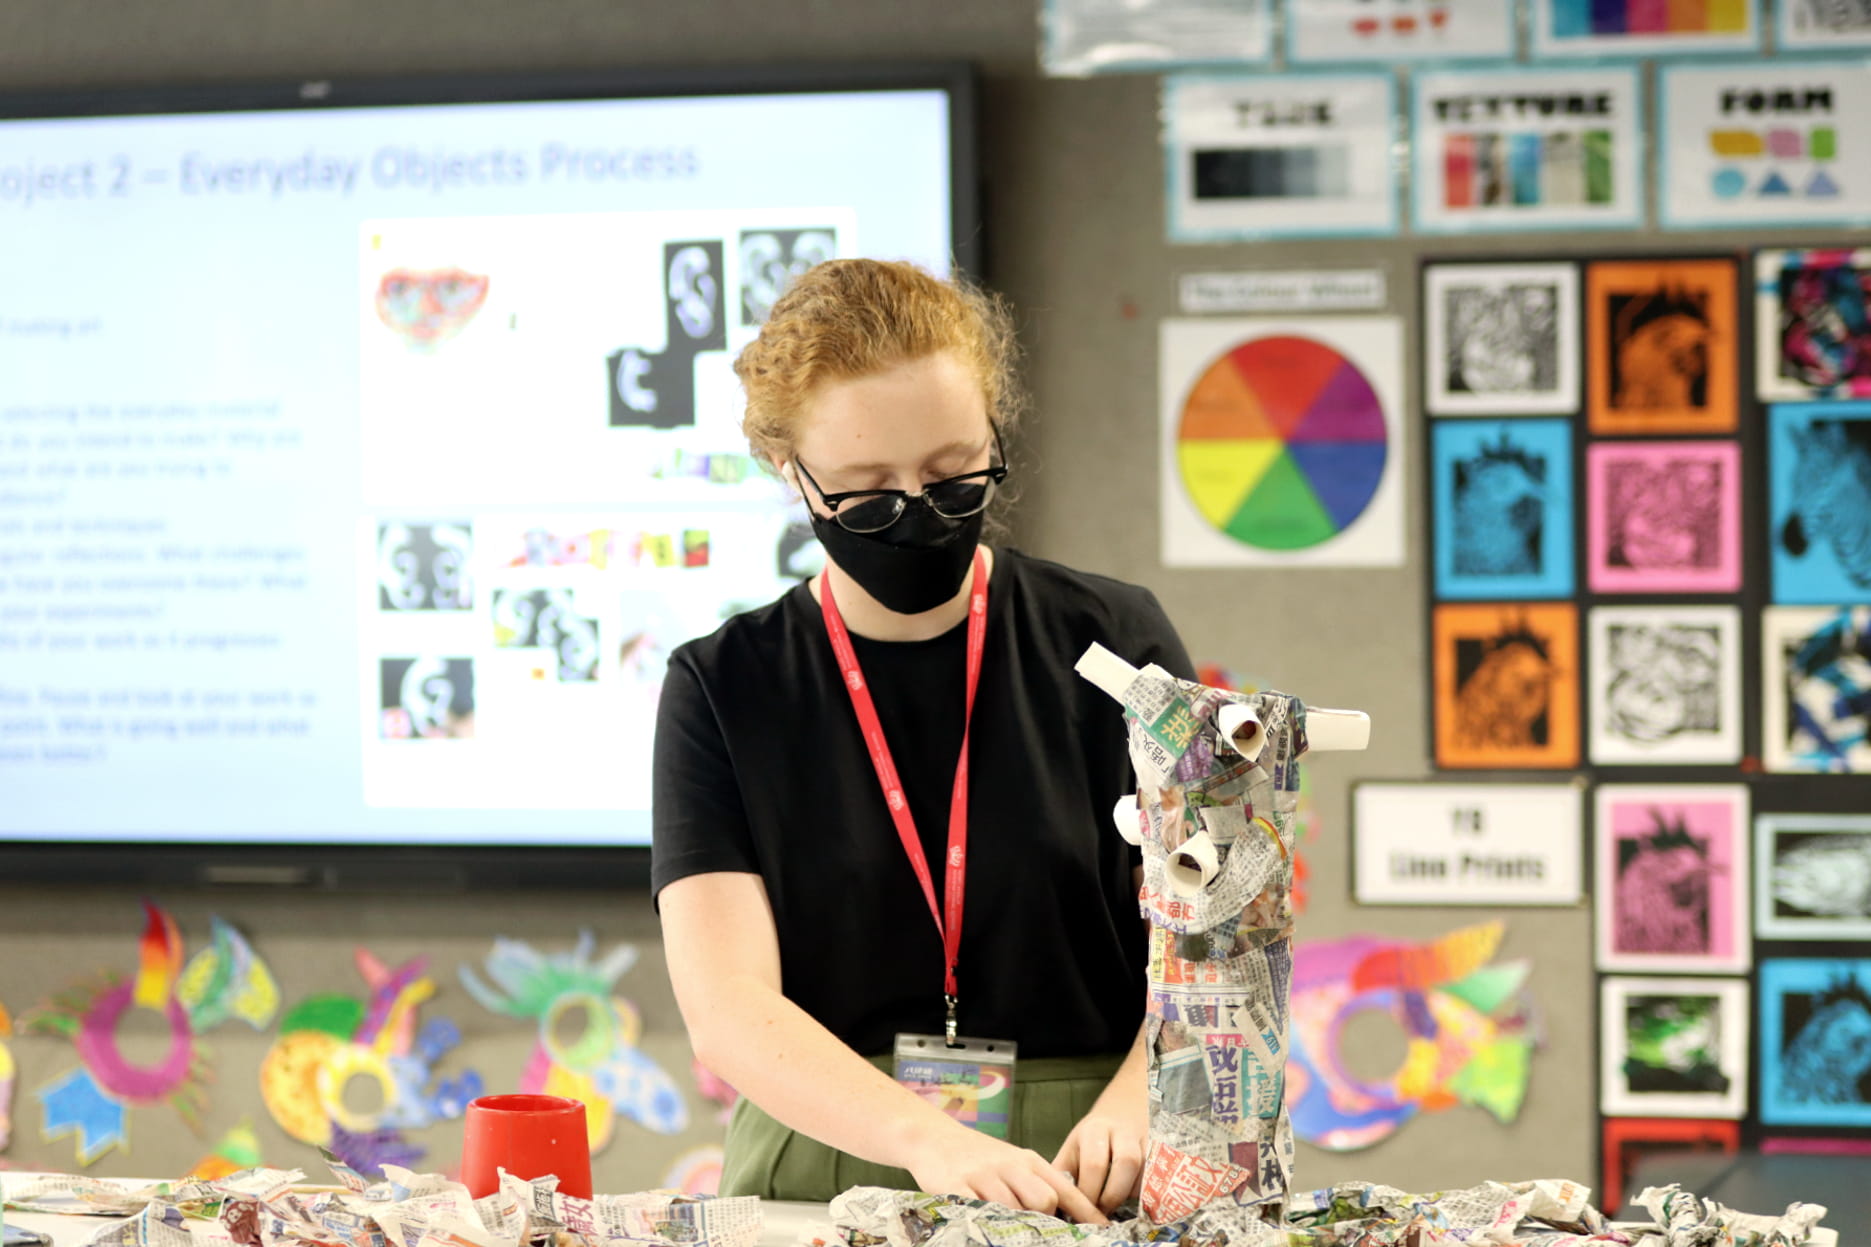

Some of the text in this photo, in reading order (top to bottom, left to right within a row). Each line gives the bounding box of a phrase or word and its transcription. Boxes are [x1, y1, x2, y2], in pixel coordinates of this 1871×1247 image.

[1719, 87, 1835, 114] FORM
[107, 152, 132, 196] 2
[179, 149, 361, 200] Everyday
[370, 145, 529, 193] Objects
[540, 141, 700, 186] Process
